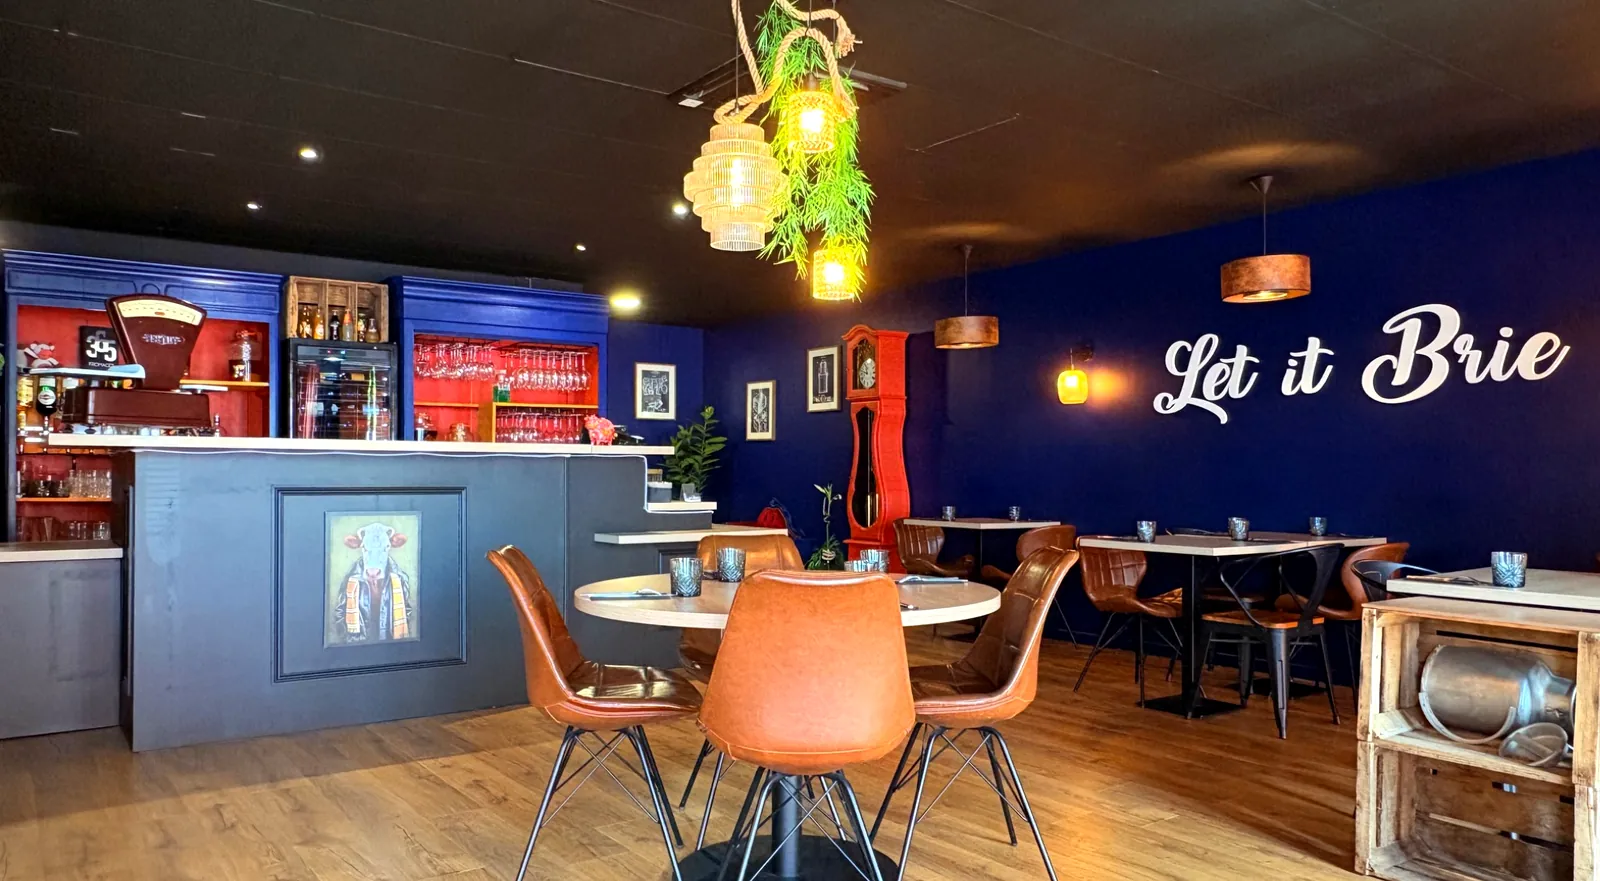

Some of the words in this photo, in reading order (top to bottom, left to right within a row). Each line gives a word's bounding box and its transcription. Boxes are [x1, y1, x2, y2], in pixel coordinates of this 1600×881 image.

[1153, 333, 1260, 425] Let
[1281, 336, 1335, 396] it
[1361, 303, 1571, 404] Brie
